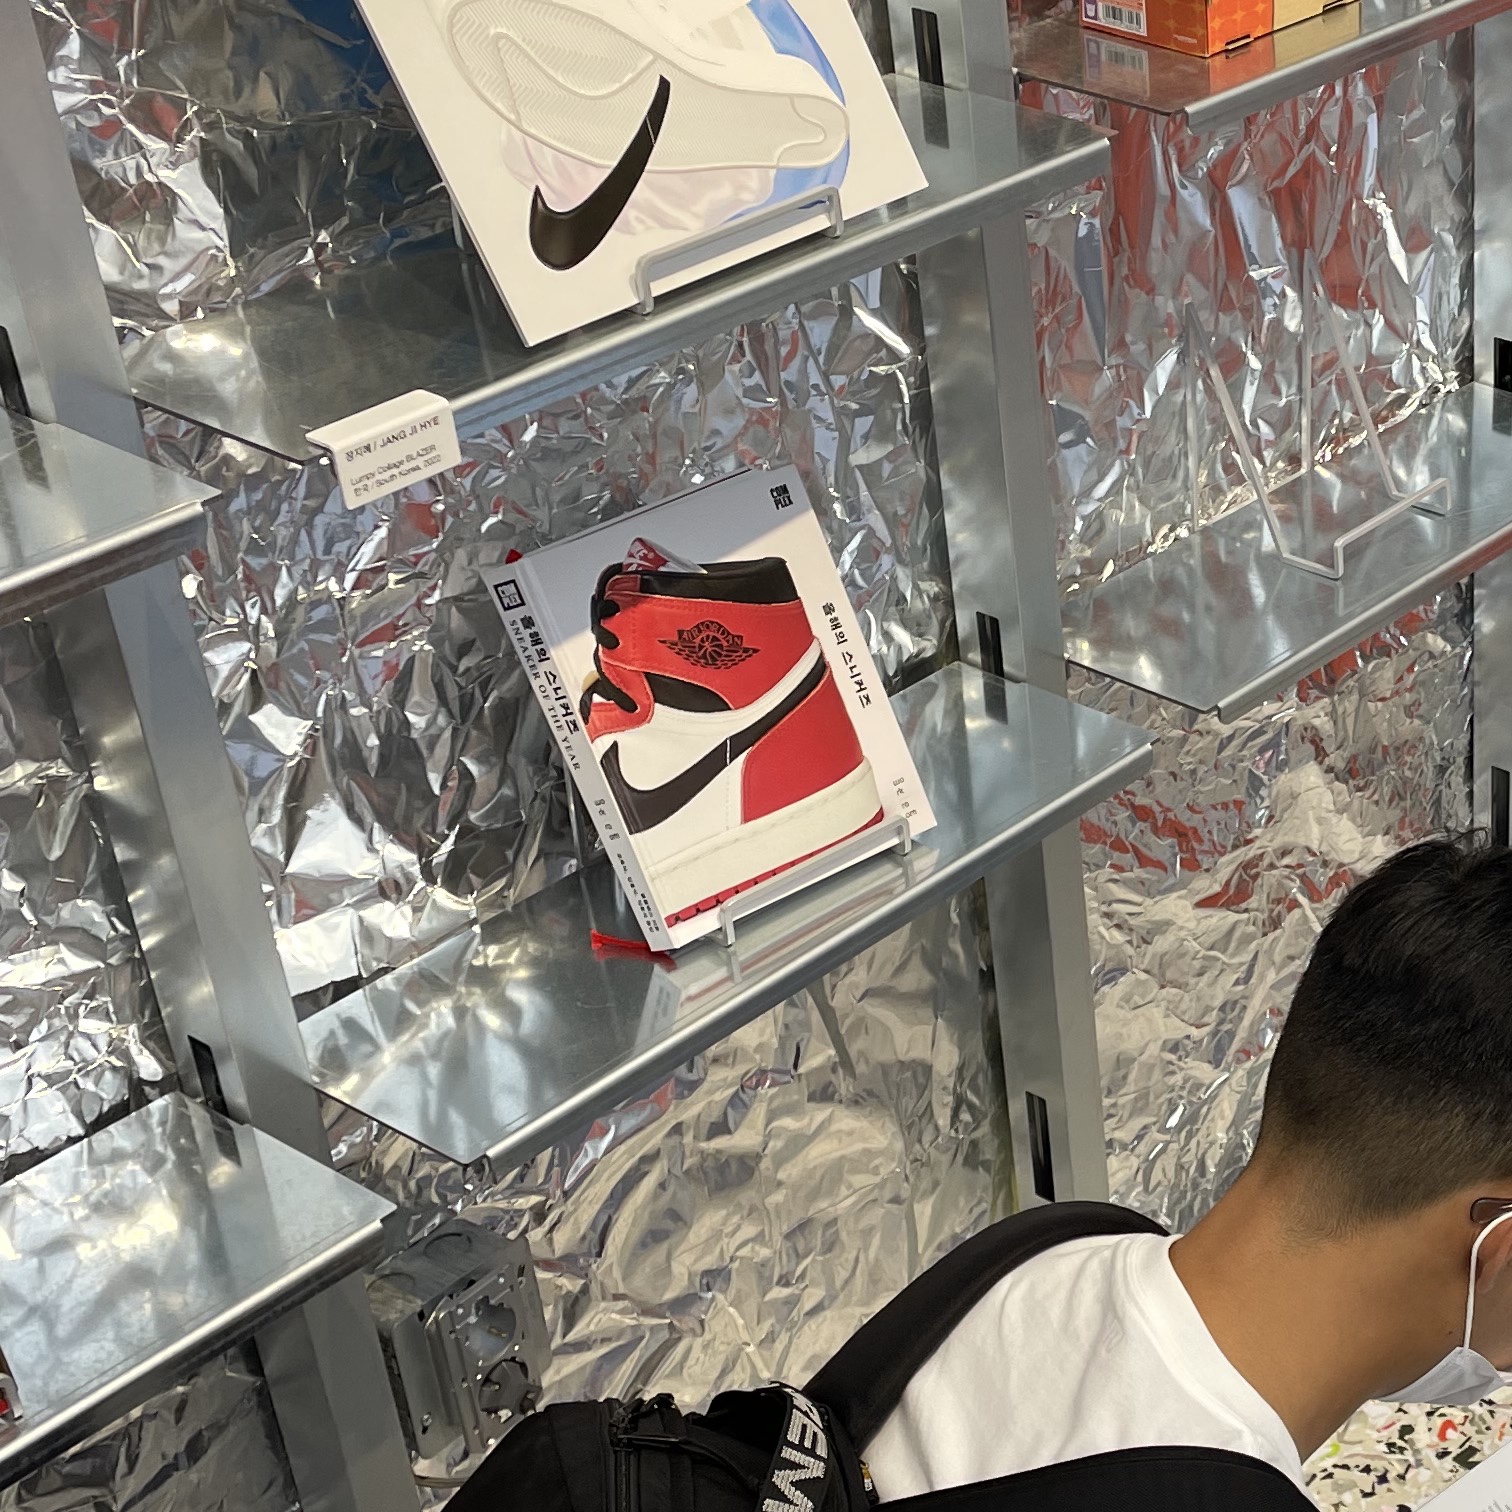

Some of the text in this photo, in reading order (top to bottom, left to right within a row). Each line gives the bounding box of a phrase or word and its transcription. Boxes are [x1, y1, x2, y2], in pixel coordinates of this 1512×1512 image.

[380, 430, 407, 448] JANG
[419, 416, 440, 431] HYE
[509, 619, 541, 681] SNEAKER
[538, 684, 550, 701] OF
[548, 706, 565, 732] THE
[562, 735, 581, 771] YEAR
[520, 614, 580, 735] 올해의 스니커즈
[822, 602, 872, 709] 올해의 스니커즈
